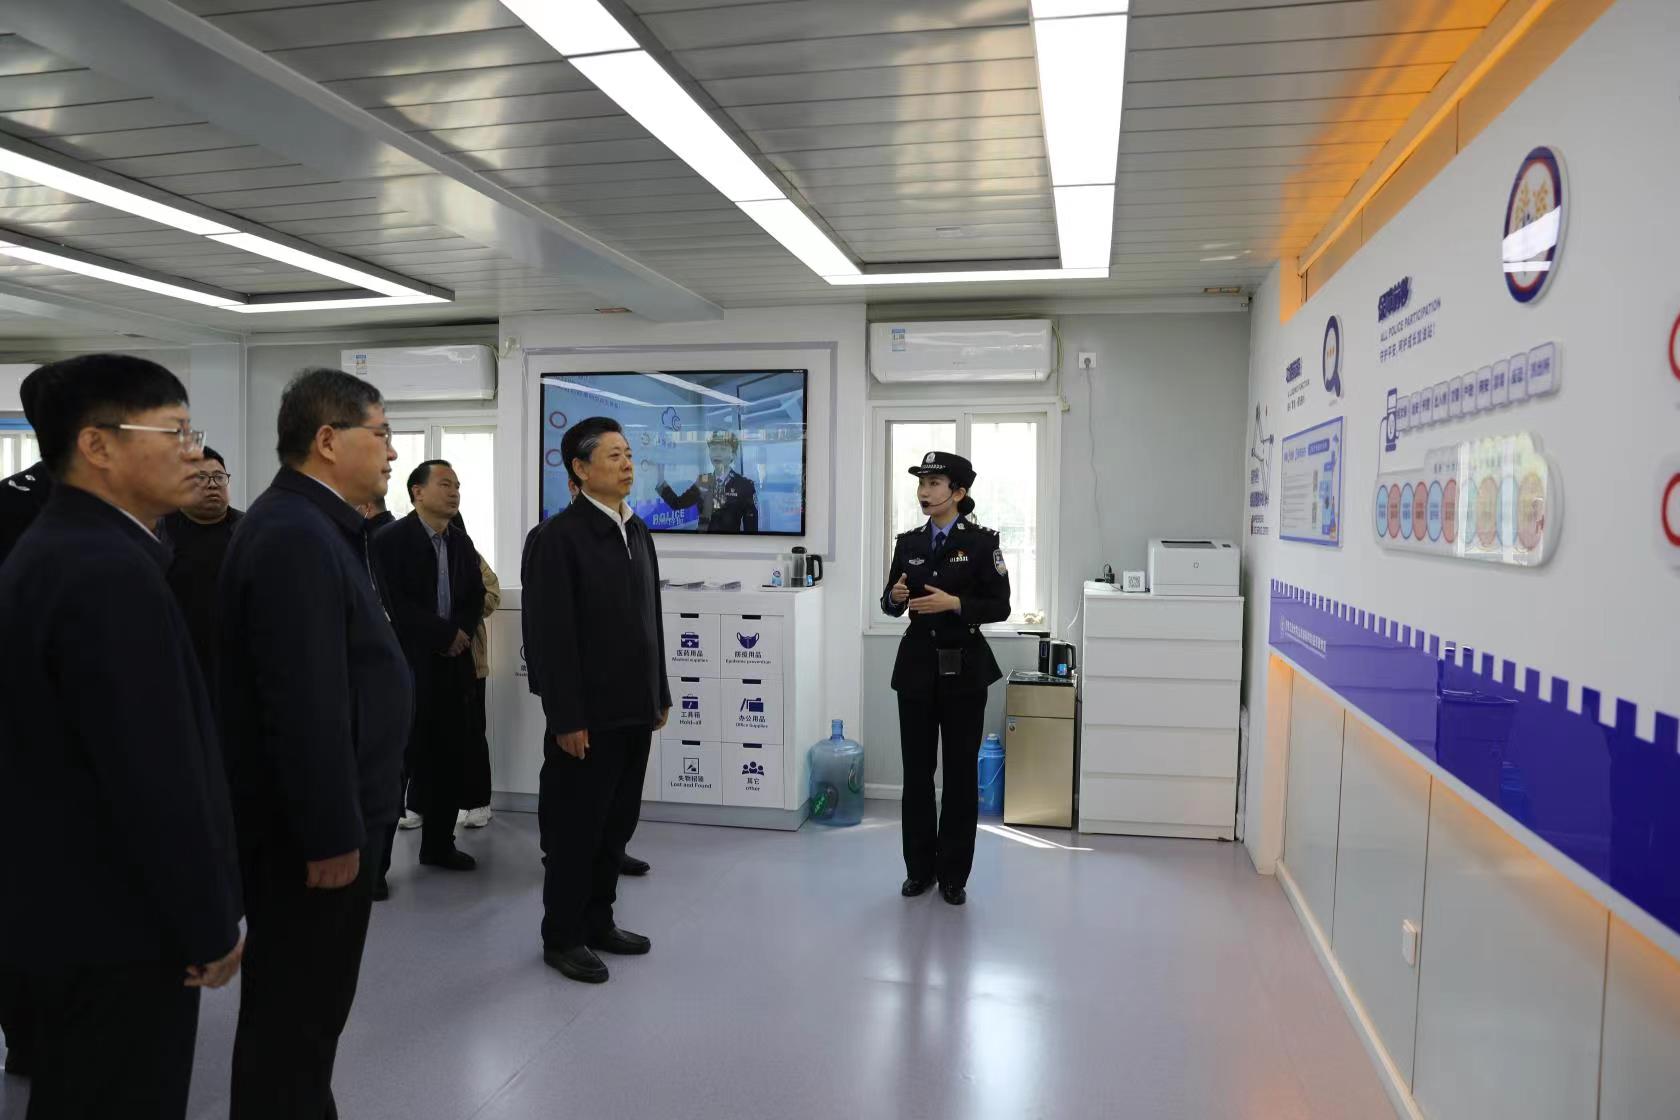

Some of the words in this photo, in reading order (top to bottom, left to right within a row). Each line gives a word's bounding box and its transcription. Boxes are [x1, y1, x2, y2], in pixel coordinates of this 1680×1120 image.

[676, 649, 703, 657] 医药用品
[734, 651, 762, 659] 防疫用品
[681, 711, 701, 719] 工具箱
[738, 715, 766, 723] 办公用品
[746, 777, 760, 785] 其它
